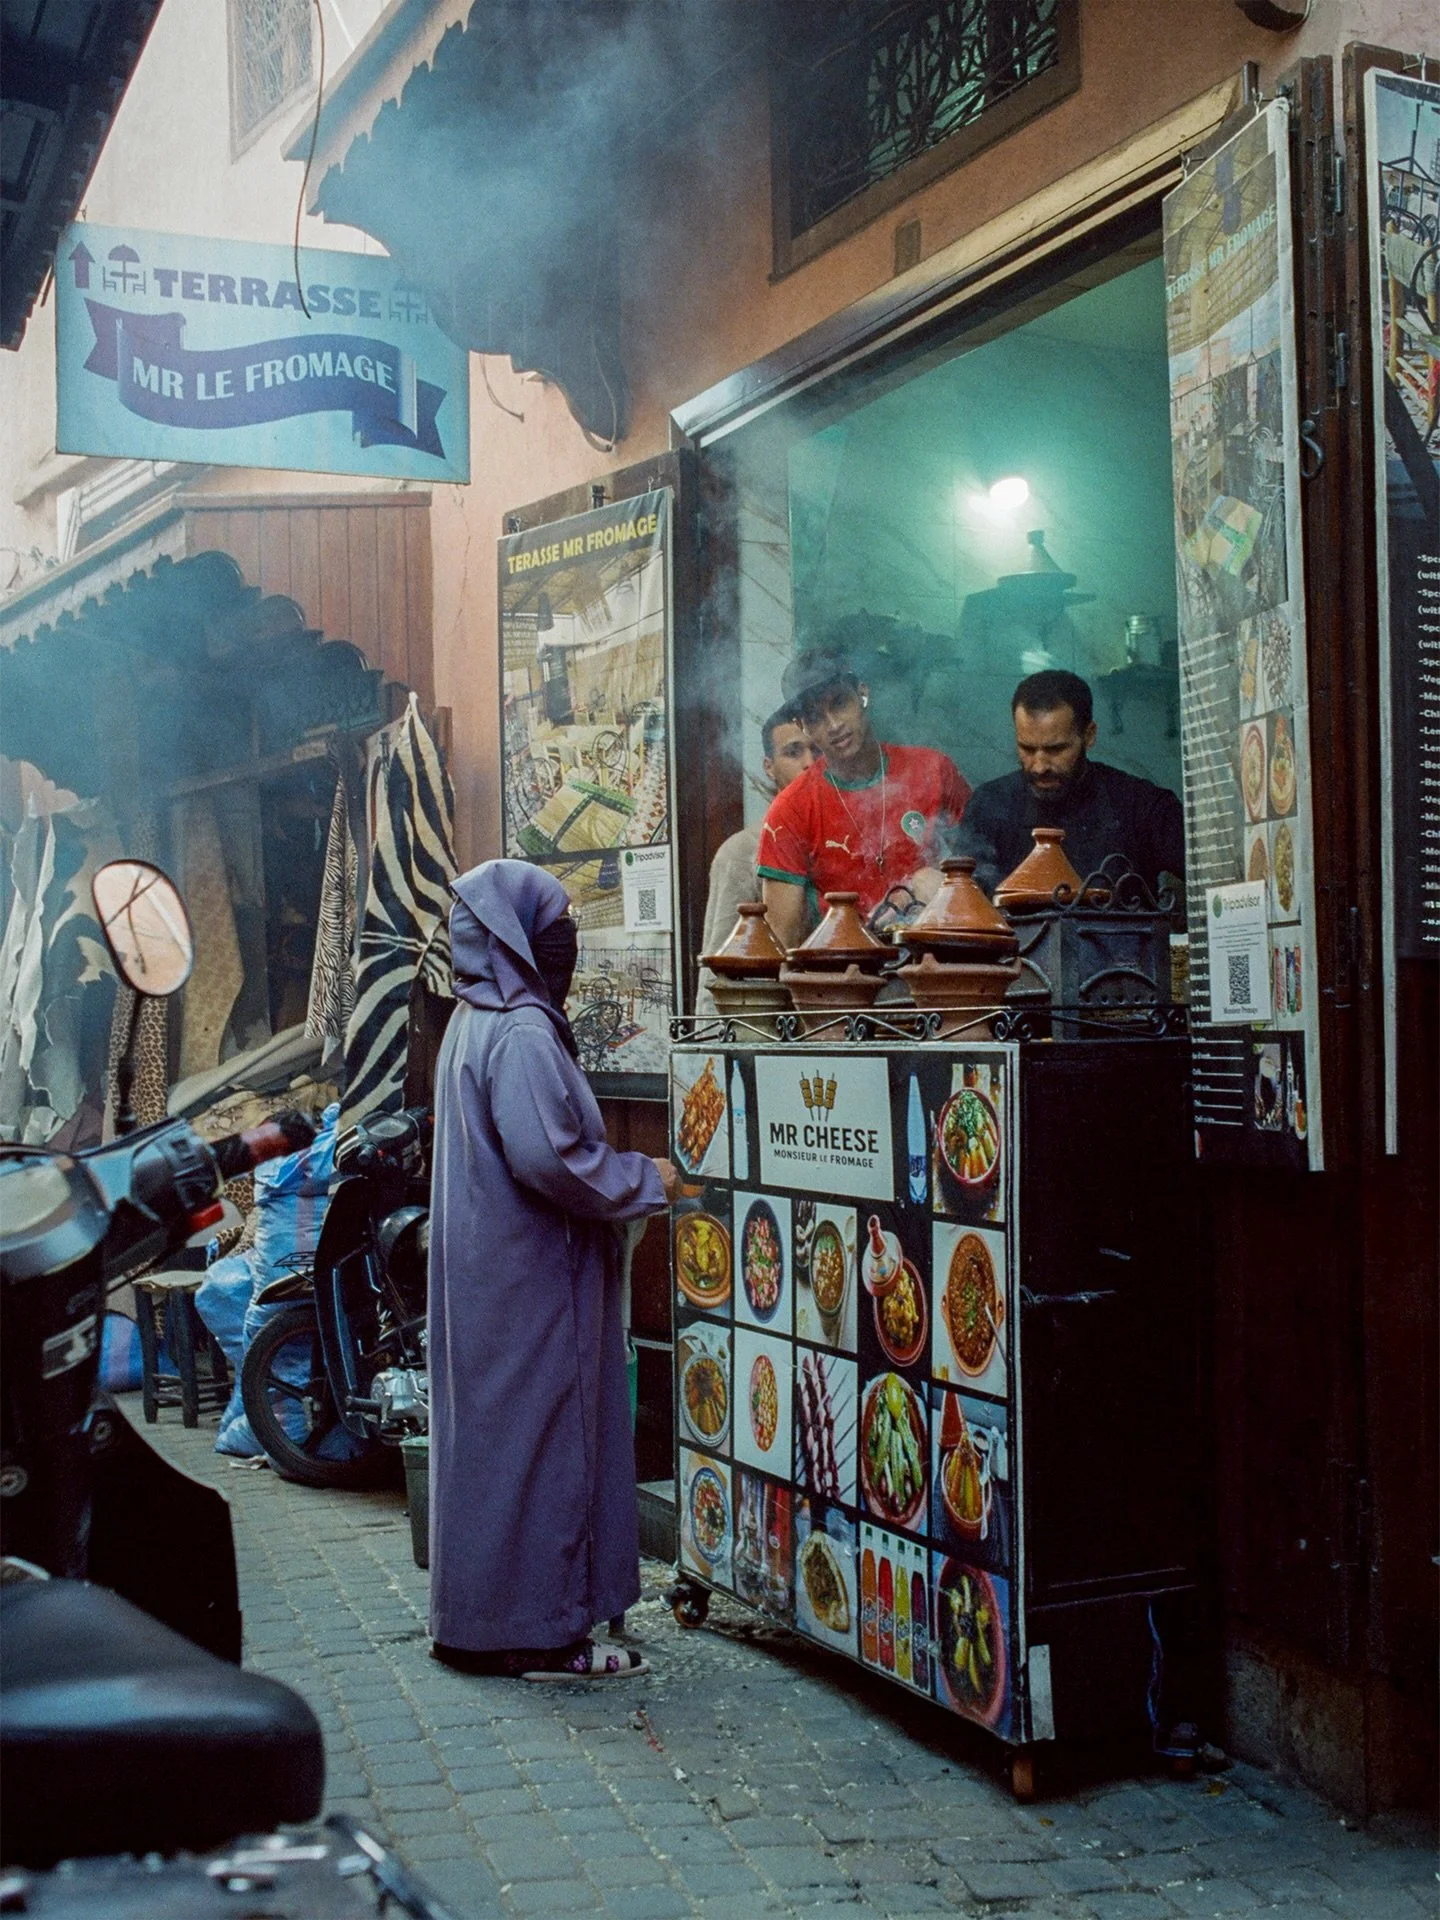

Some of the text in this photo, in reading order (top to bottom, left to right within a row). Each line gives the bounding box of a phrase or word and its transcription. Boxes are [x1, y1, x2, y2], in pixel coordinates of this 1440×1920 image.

[1226, 203, 1277, 260] FROMAGE
[154, 268, 381, 319] TERRASSE
[133, 350, 397, 401] MR LE FROMAGE
[507, 513, 657, 574] TERASSE MR FROMAGE
[769, 1122, 880, 1154] MR CHEESE
[773, 1149, 874, 1169] MONSIEUR LE FROMAGE
